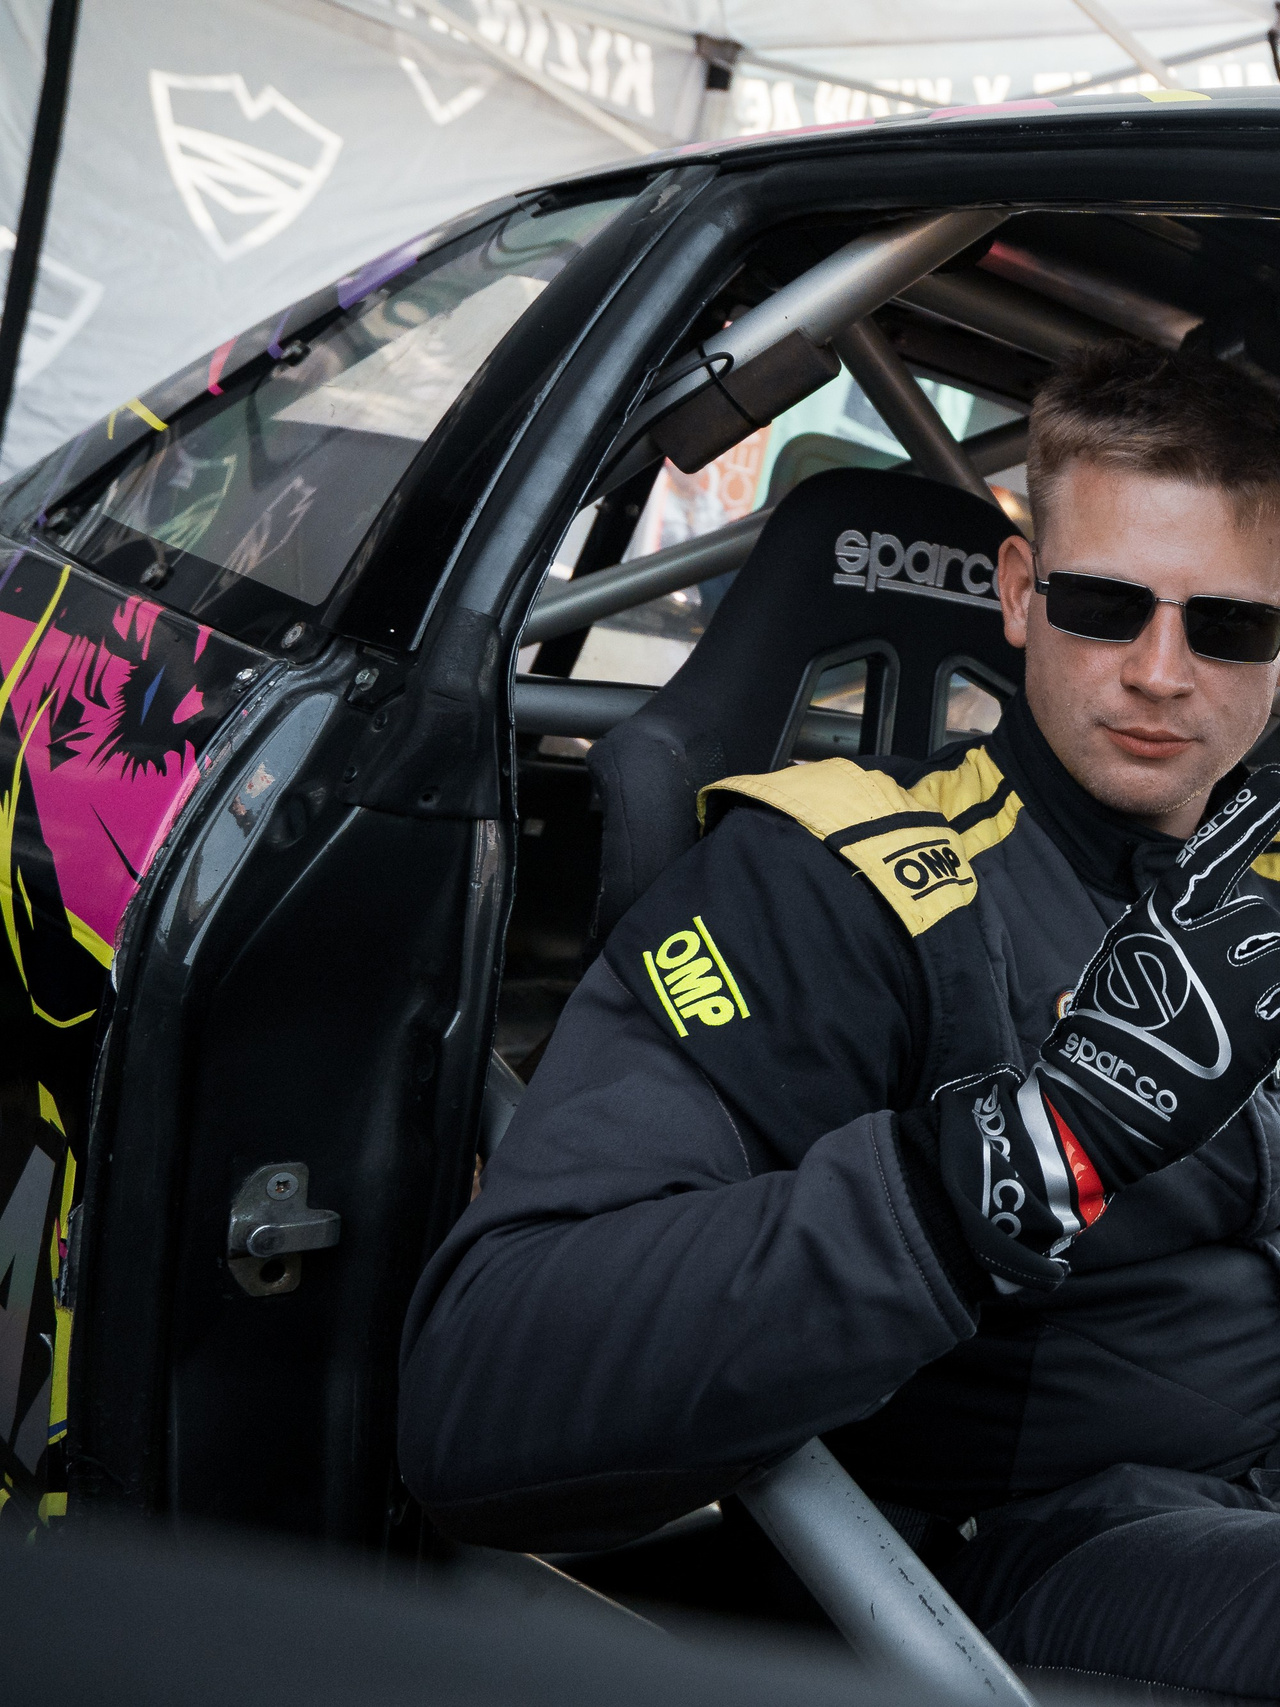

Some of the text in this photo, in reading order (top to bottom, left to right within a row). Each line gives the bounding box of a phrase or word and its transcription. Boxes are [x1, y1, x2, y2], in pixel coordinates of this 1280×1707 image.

[835, 529, 1001, 598] sparc
[1175, 788, 1252, 864] sparco
[893, 847, 961, 890] OMP
[655, 930, 735, 1026] OMP
[1064, 1032, 1178, 1114] sparco
